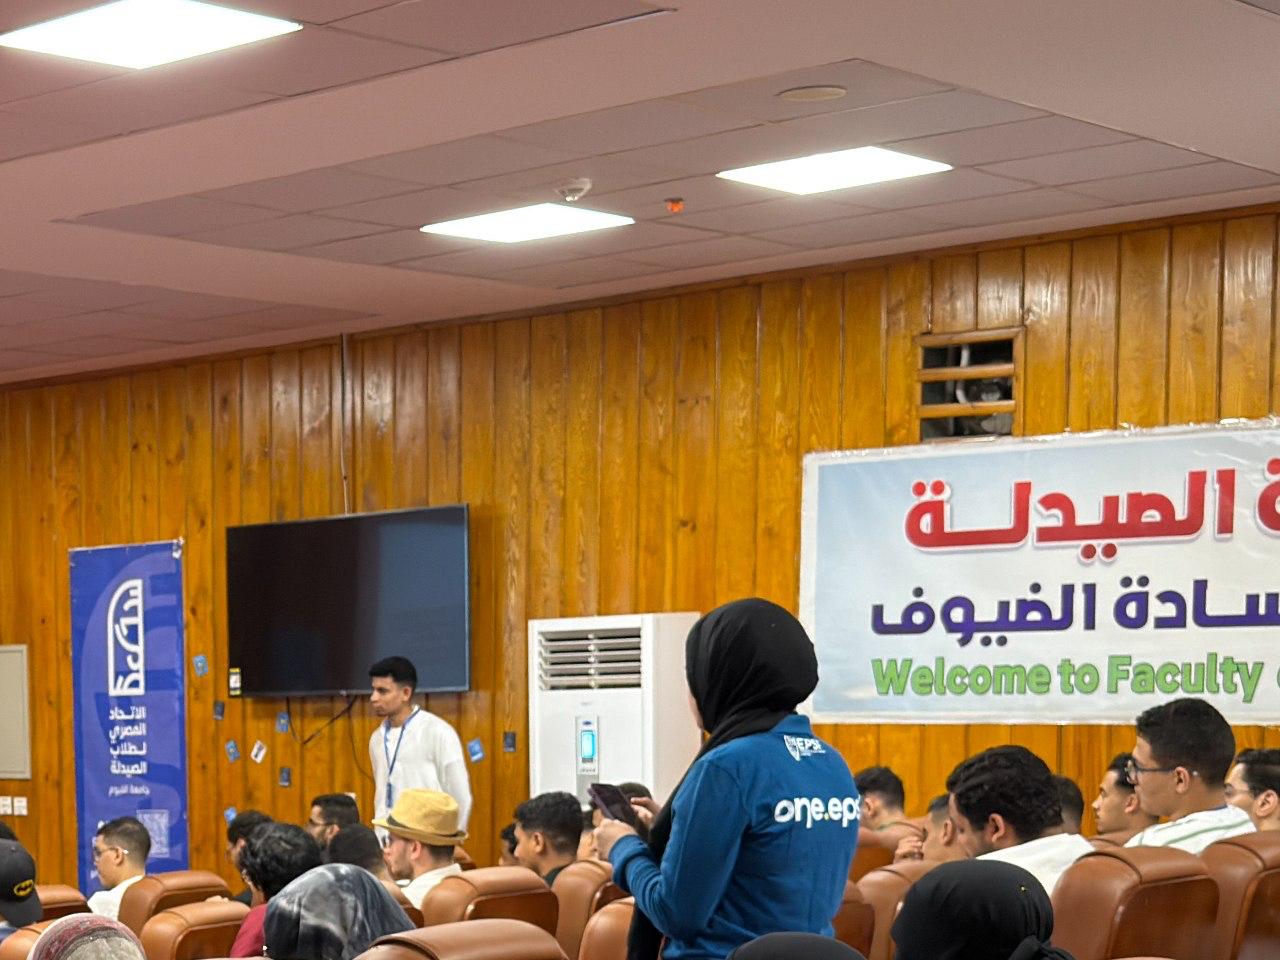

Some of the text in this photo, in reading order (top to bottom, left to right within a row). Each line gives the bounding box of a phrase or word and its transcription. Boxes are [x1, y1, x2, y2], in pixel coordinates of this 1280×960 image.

[905, 468, 1236, 561] الصيدلة
[872, 582, 1096, 648] الضيوف
[872, 657, 1051, 696] Welcome
[1058, 659, 1100, 695] to
[1107, 652, 1264, 703] Faculty
[109, 705, 147, 720] الاتحاد
[108, 722, 147, 744] المصري
[110, 760, 148, 779] الصيدلة
